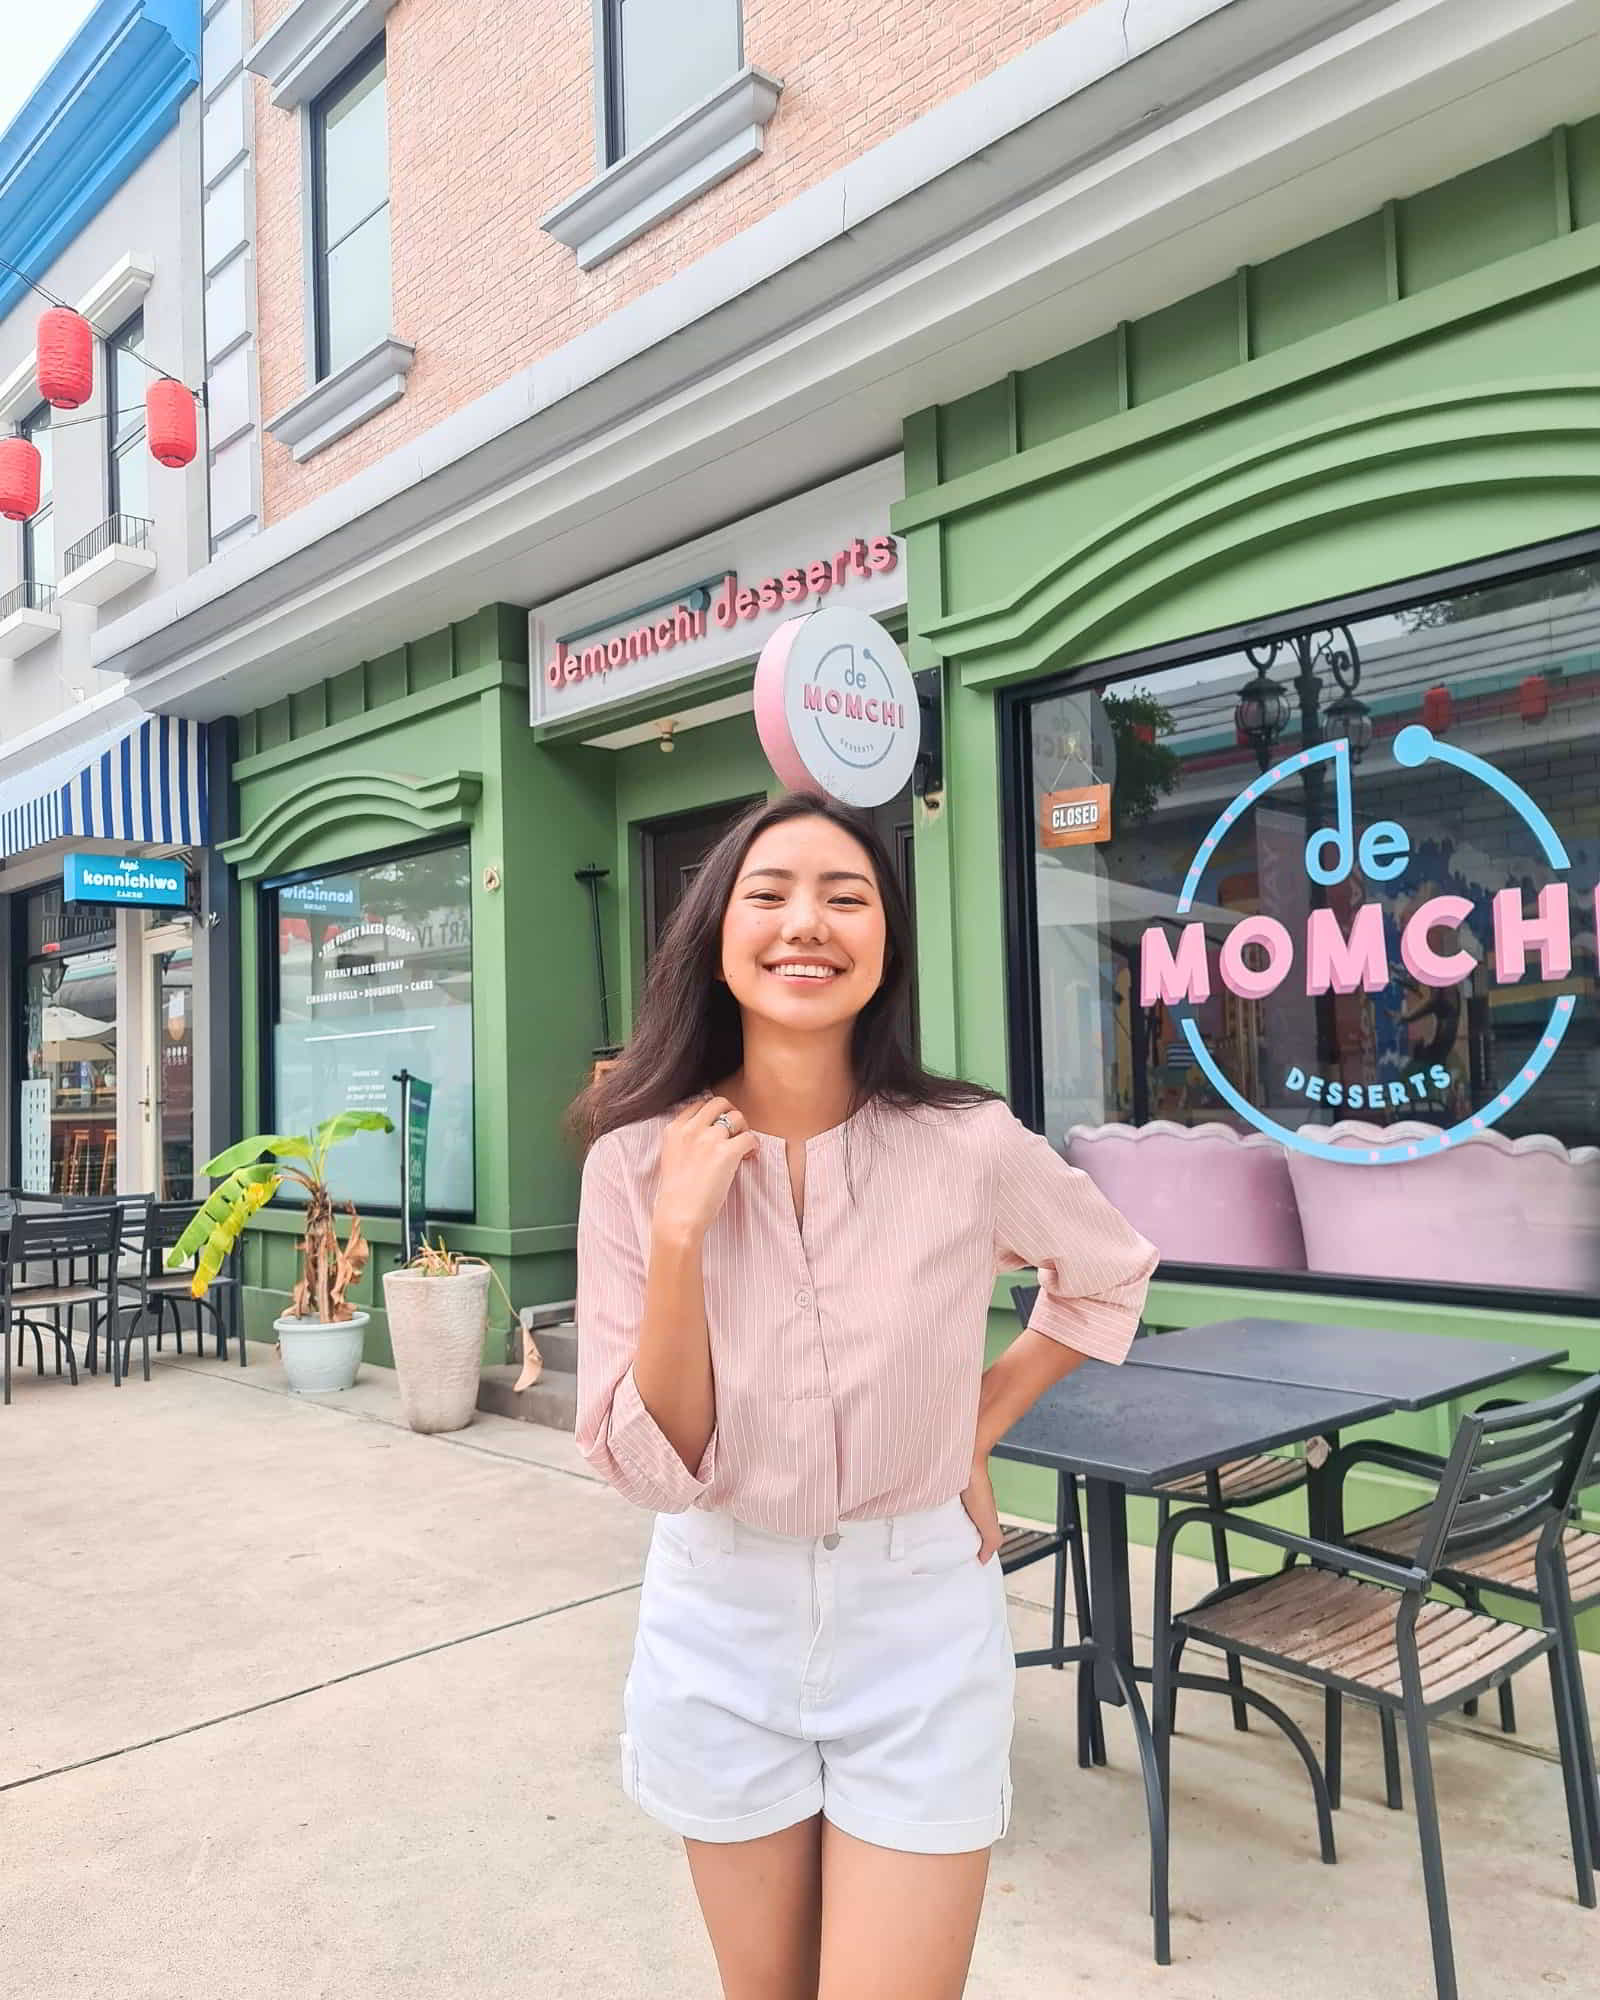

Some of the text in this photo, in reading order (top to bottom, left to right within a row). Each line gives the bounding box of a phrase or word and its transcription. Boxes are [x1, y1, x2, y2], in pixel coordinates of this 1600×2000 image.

[545, 535, 898, 690] demomchi desserts
[844, 644, 867, 689] de
[802, 683, 905, 730] MOMCHI
[1052, 804, 1099, 829] CLOSED
[1304, 737, 1410, 887] de
[83, 868, 178, 891] konnichiwa
[335, 925, 360, 946] FINEST
[360, 923, 385, 936] BAKED
[384, 924, 411, 942] GOODS
[1140, 881, 1600, 1008] MOMCH
[338, 989, 358, 1001] ROLLS
[410, 979, 434, 992] CAKES
[351, 965, 370, 976] MADE
[370, 959, 404, 974] EVERYDAY
[1285, 1064, 1451, 1109] DESSERTS
